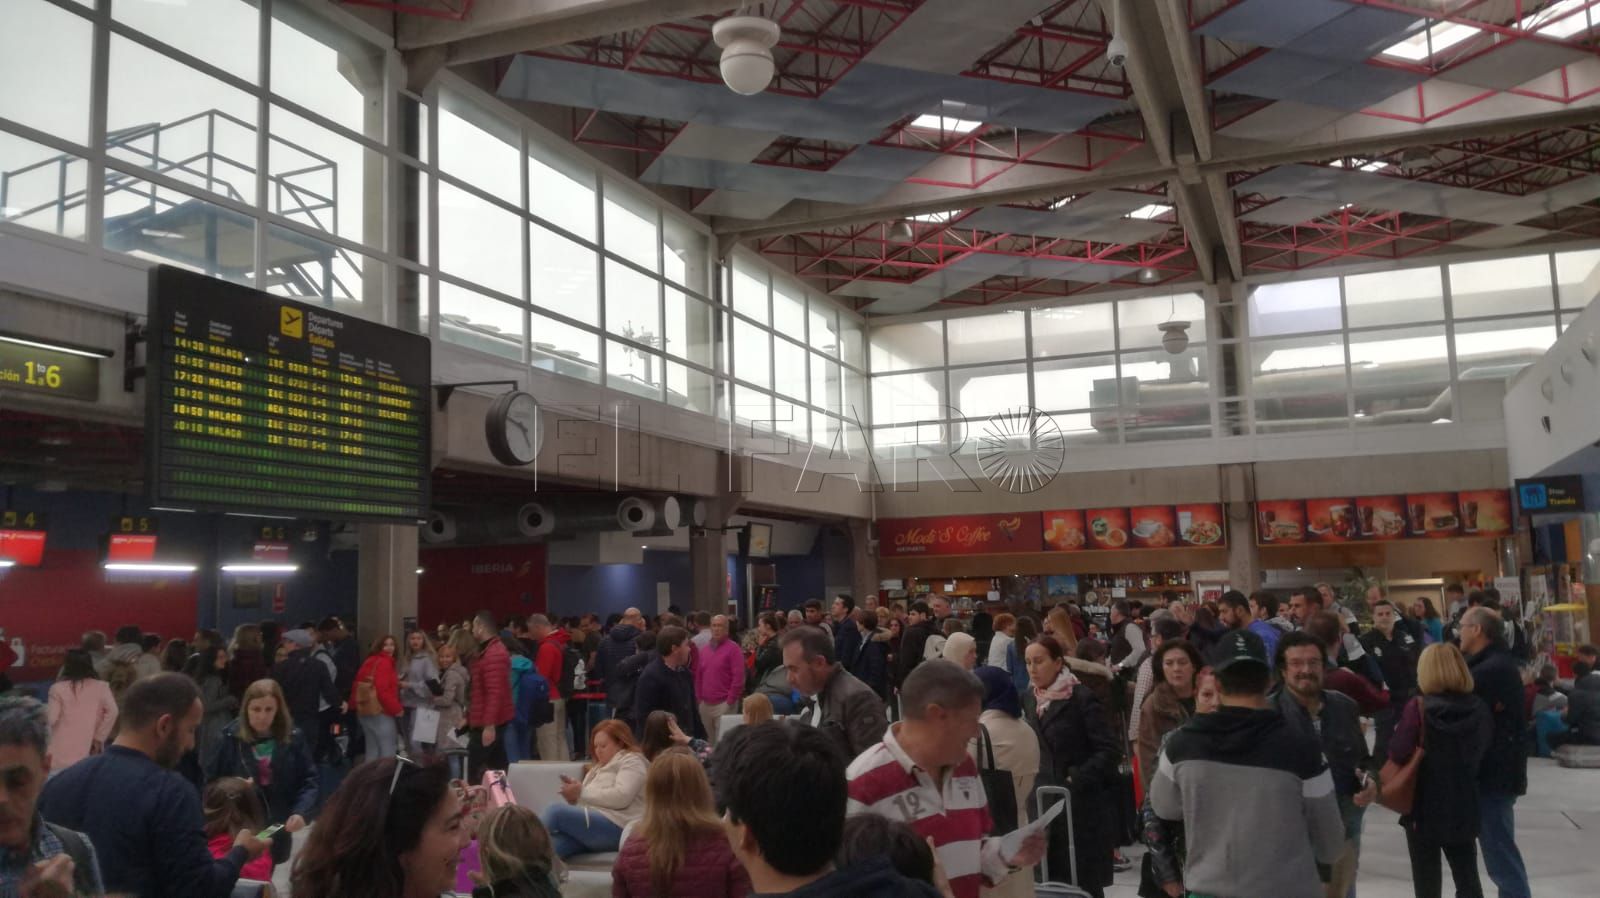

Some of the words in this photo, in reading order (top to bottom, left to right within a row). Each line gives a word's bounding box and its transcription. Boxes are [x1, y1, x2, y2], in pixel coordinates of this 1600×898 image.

[308, 312, 344, 328] Departures
[308, 323, 334, 336] Départs
[175, 337, 204, 352] 14:30
[209, 345, 243, 360] MALAGA
[175, 354, 204, 368] 15:55
[175, 370, 204, 385] 17:20
[208, 377, 242, 392] MALAGA
[174, 386, 203, 401] 18:20
[208, 393, 242, 407] MALAGA
[267, 403, 284, 415] AEA
[208, 409, 242, 423] MALAGA
[207, 426, 242, 439] MALAGA
[24, 512, 36, 527] 4
[139, 518, 148, 531] 5
[471, 563, 513, 574] IBERIA
